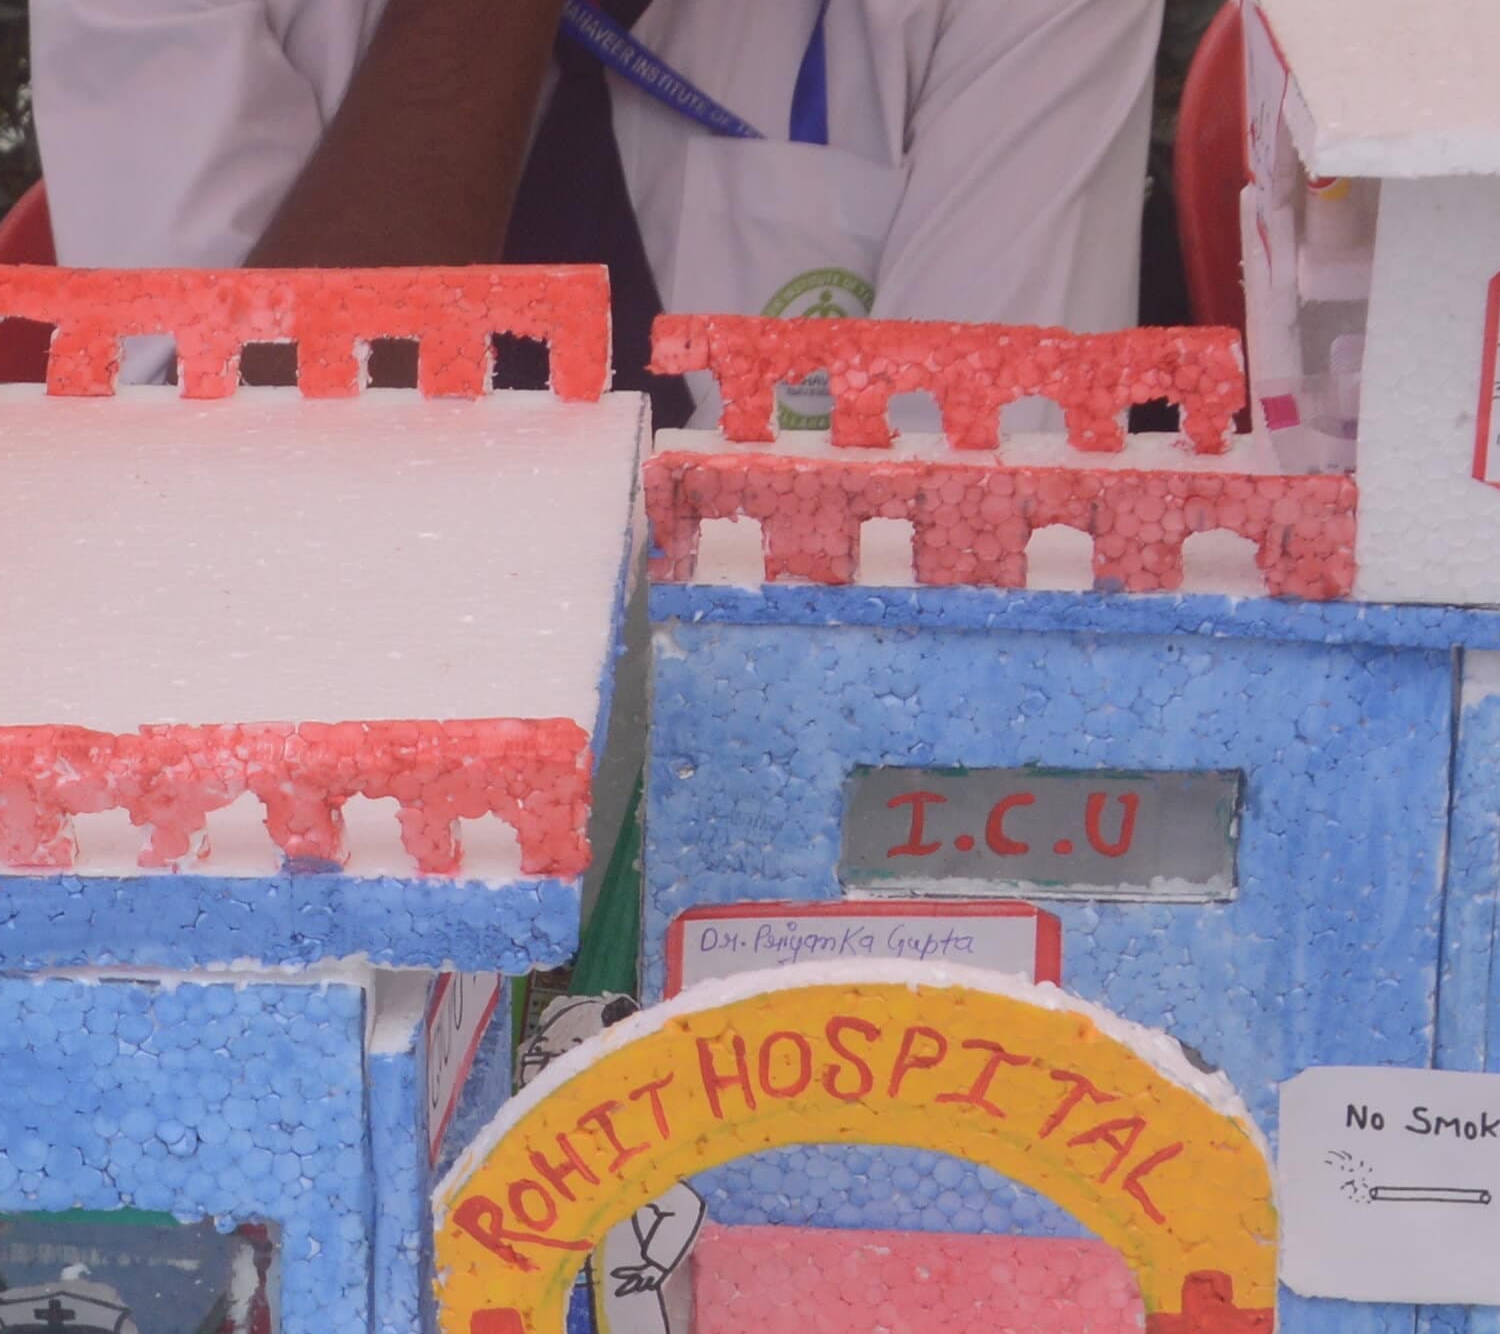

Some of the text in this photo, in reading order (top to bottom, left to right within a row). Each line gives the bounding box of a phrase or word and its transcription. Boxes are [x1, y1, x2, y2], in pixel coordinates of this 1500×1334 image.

[886, 791, 1140, 859] I.C.U
[887, 923, 976, 960] Gupta
[453, 1014, 1185, 1272] ROHIT HOSPITAL
[1345, 1104, 1385, 1131] No
